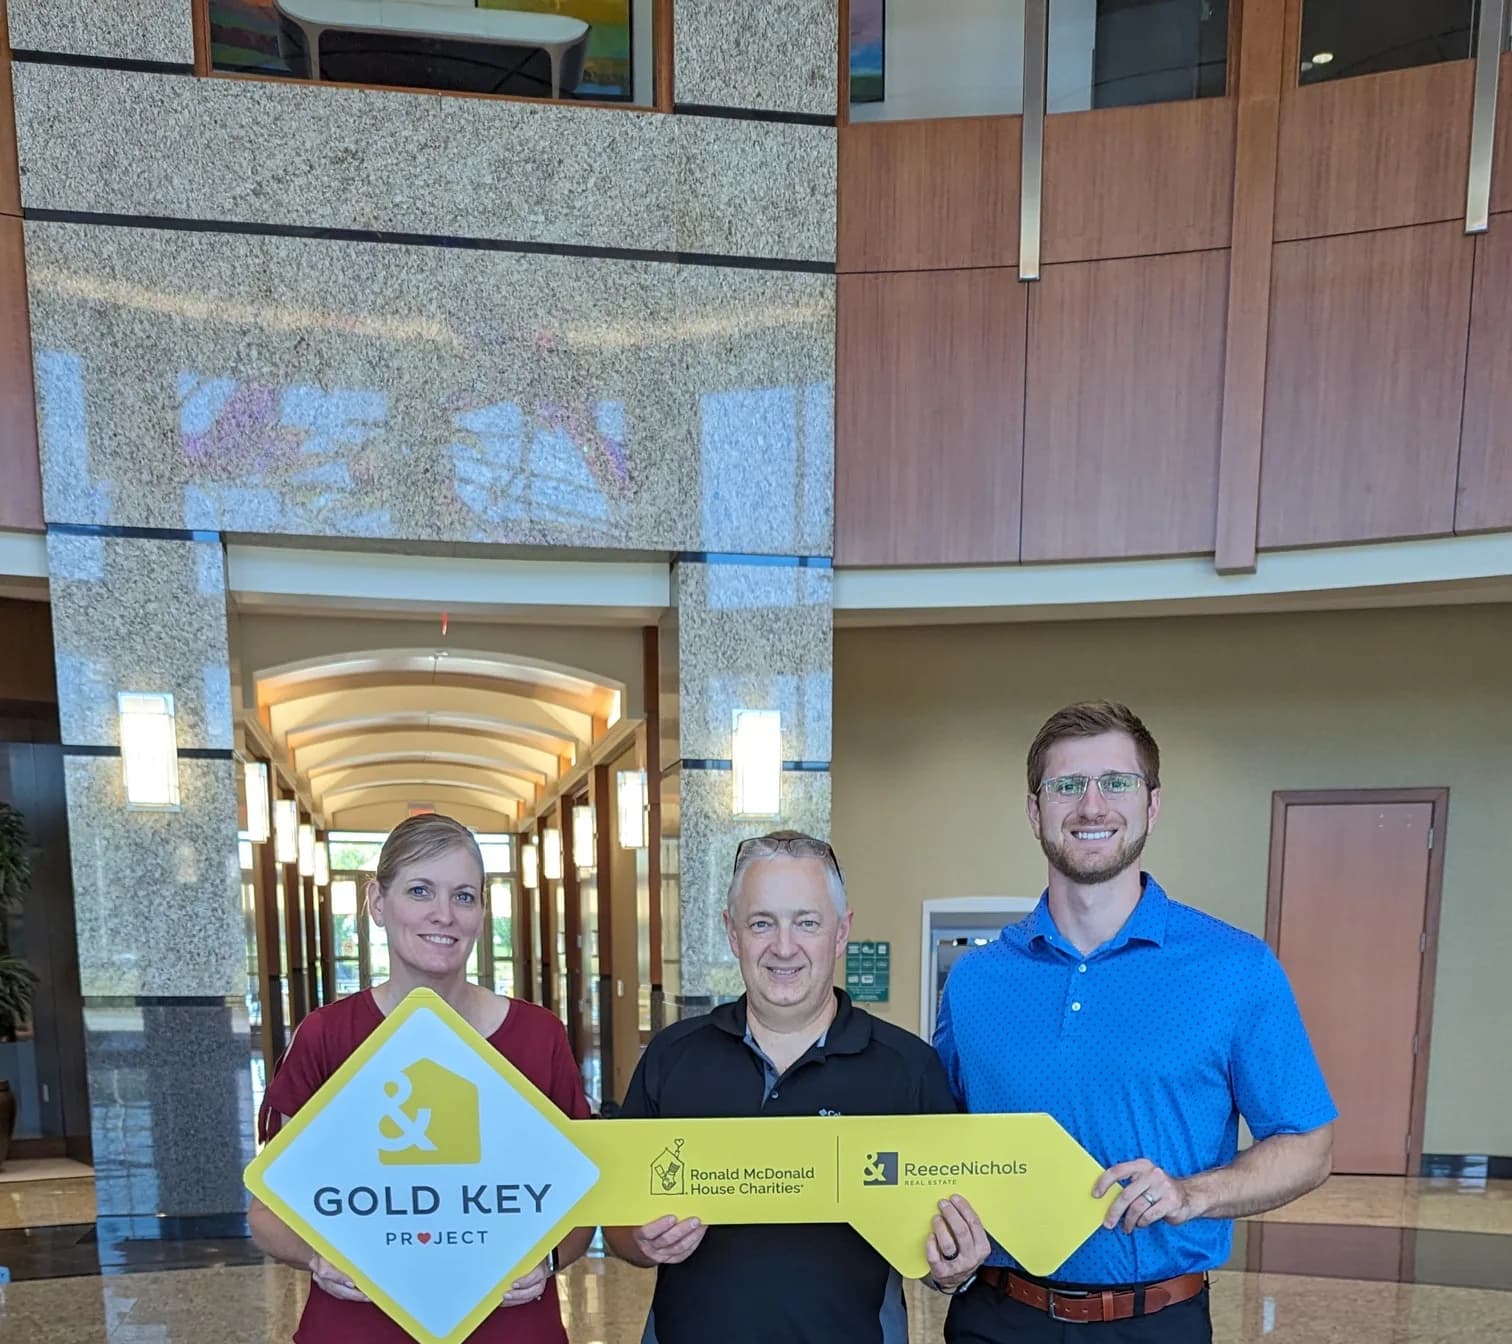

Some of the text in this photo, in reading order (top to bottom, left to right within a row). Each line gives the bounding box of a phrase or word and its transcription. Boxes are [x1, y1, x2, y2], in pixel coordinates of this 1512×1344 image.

[691, 1168, 815, 1180] Ronald McDonald
[904, 1161, 1028, 1177] ReeceNichols
[691, 1183, 735, 1195] House
[313, 1184, 552, 1216] GOLD KEY
